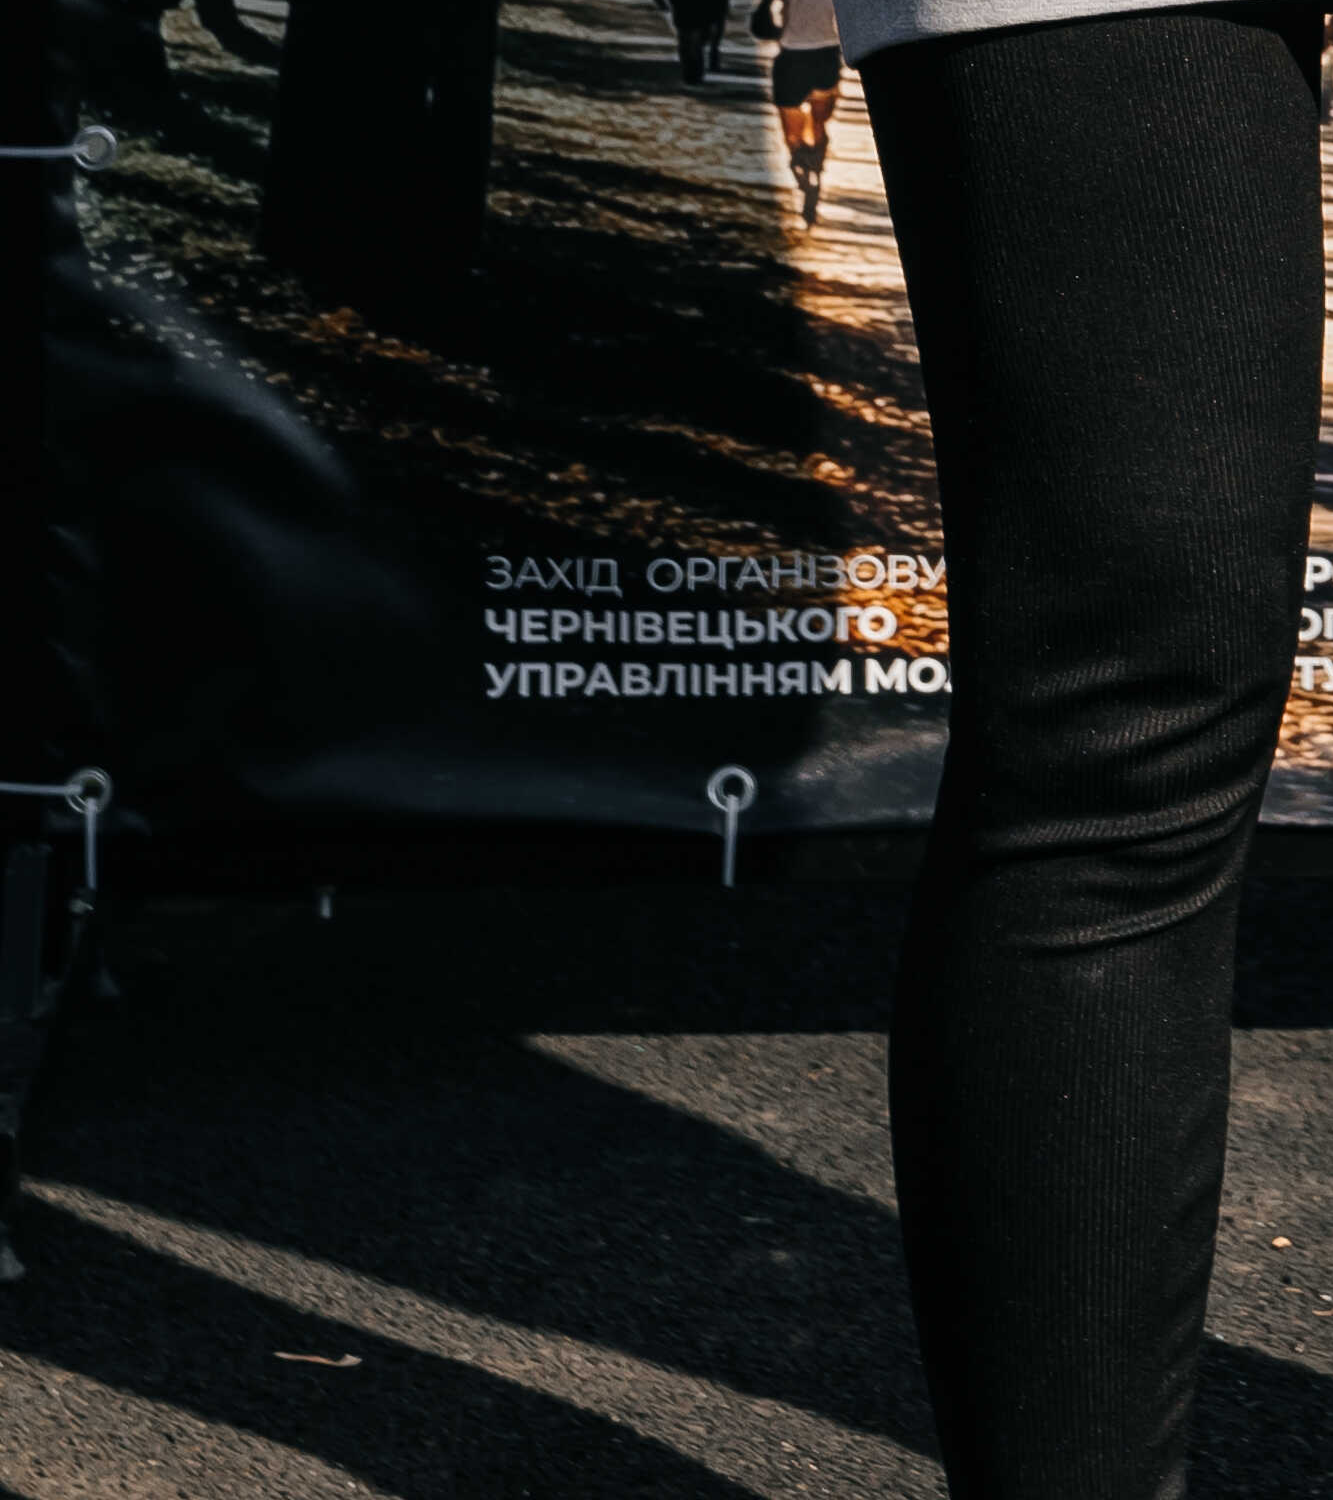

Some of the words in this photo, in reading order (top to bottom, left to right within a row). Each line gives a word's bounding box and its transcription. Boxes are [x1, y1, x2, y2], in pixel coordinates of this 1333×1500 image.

[485, 555, 623, 598] ЗАХІД
[484, 608, 898, 651] ЧЕРНІВЕЦЬКОГО
[484, 658, 853, 698] УПРАВЛІННЯМ
